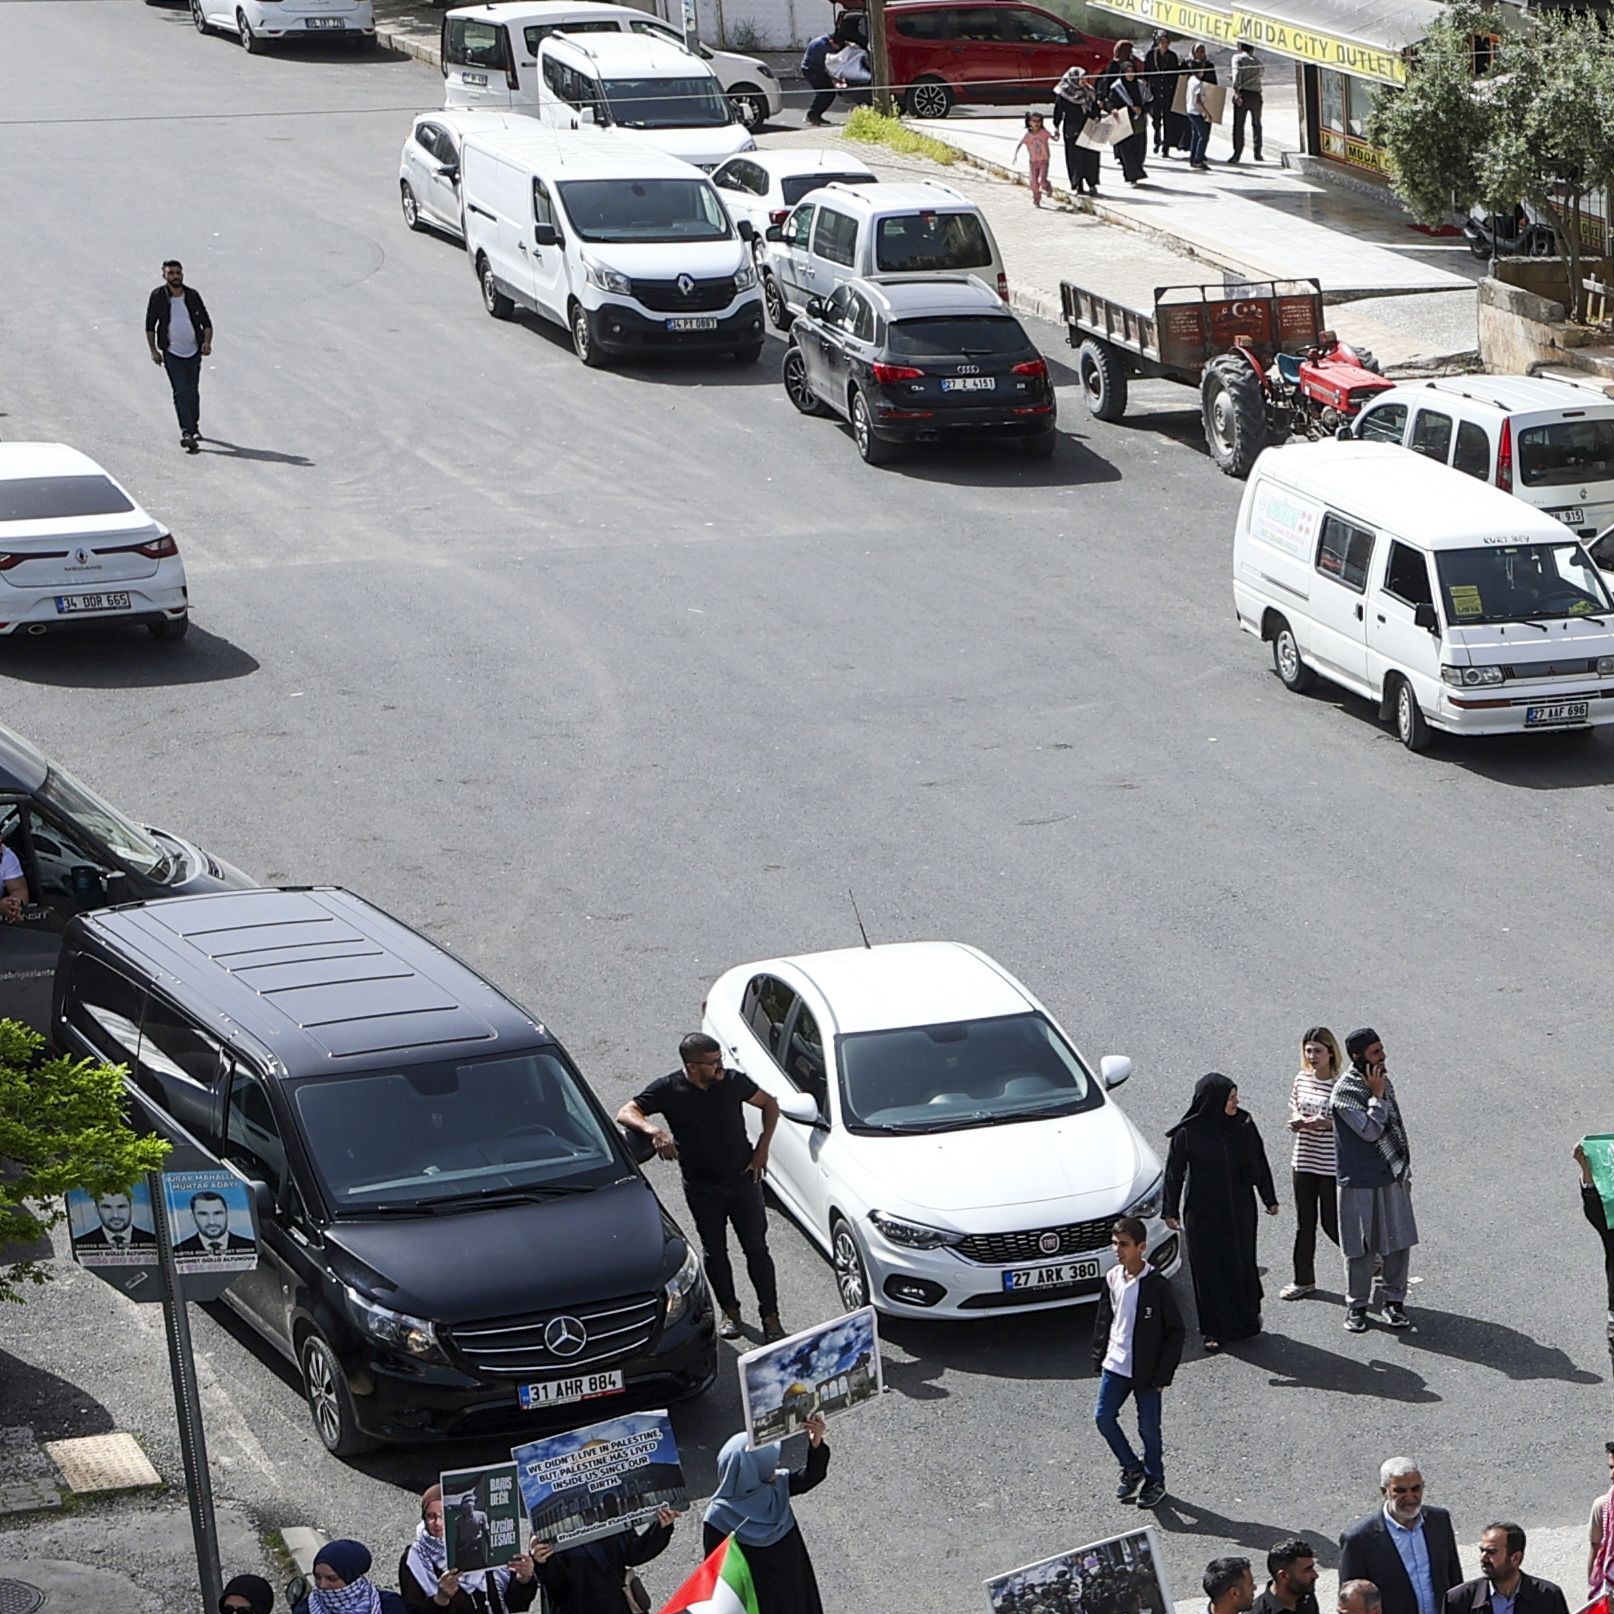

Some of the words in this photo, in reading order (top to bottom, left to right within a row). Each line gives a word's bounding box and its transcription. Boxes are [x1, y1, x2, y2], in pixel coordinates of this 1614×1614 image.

[1178, 9, 1232, 38] OUTLET
[1239, 15, 1288, 47] MODA
[1337, 41, 1395, 77] OUTLET
[1348, 144, 1377, 165] MODA
[946, 380, 956, 390] 27
[962, 380, 968, 388] Z
[972, 379, 993, 388] 4151
[1565, 510, 1581, 521] 915
[64, 594, 78, 609] 34
[108, 592, 128, 606] 665
[1532, 710, 1544, 720] 27
[1548, 708, 1563, 718] AAF
[1568, 706, 1586, 716] 696
[1013, 1270, 1032, 1288] 27
[1036, 1266, 1064, 1284] ARK
[1070, 1262, 1096, 1279] 380
[530, 1383, 548, 1402] 31
[556, 1378, 584, 1398] AHR
[589, 1374, 618, 1393] 884
[529, 1465, 543, 1474] WE
[544, 1453, 577, 1469] DIDN'T
[578, 1448, 597, 1460] LIVE
[600, 1444, 610, 1454] IN
[539, 1471, 557, 1483] BUT
[560, 1458, 608, 1477] PALESTINE
[610, 1450, 629, 1462] HAS
[630, 1442, 656, 1456] LIVED
[553, 1474, 584, 1490] INSIDE
[586, 1471, 598, 1481] US
[600, 1462, 625, 1476] SINCE
[628, 1456, 649, 1468] OUR
